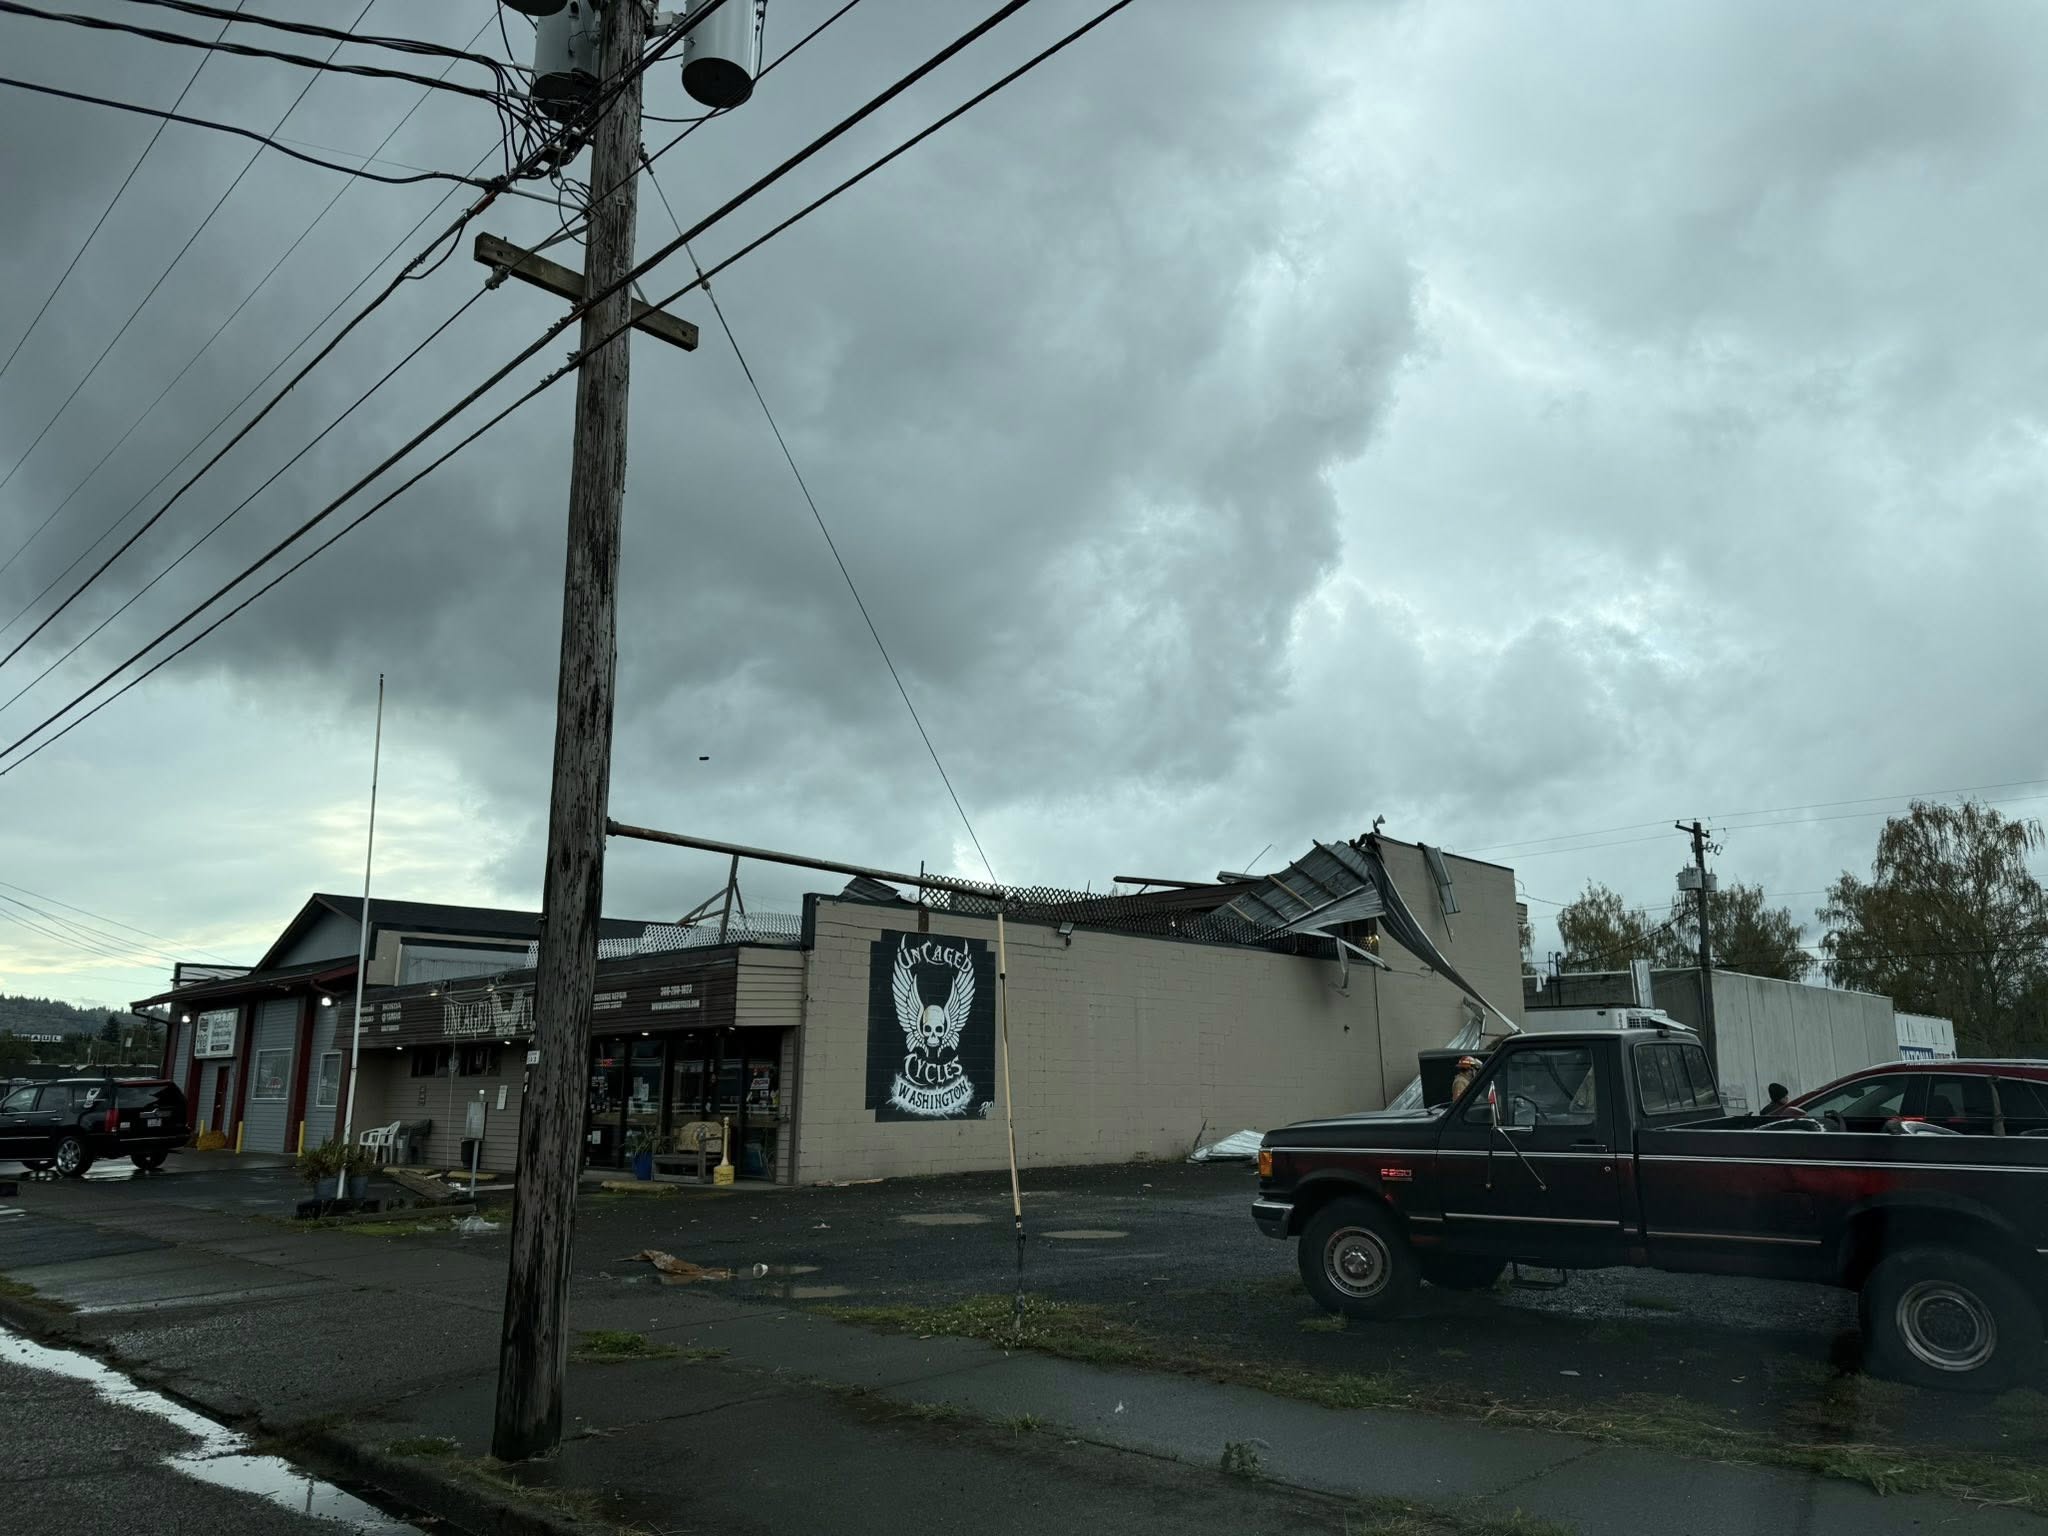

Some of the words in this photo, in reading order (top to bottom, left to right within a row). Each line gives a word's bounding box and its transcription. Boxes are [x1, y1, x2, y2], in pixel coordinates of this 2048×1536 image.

[897, 940, 973, 973] UNCAGED
[904, 1053, 963, 1086] CYCLES
[898, 1080, 968, 1110] WASHINGTON
